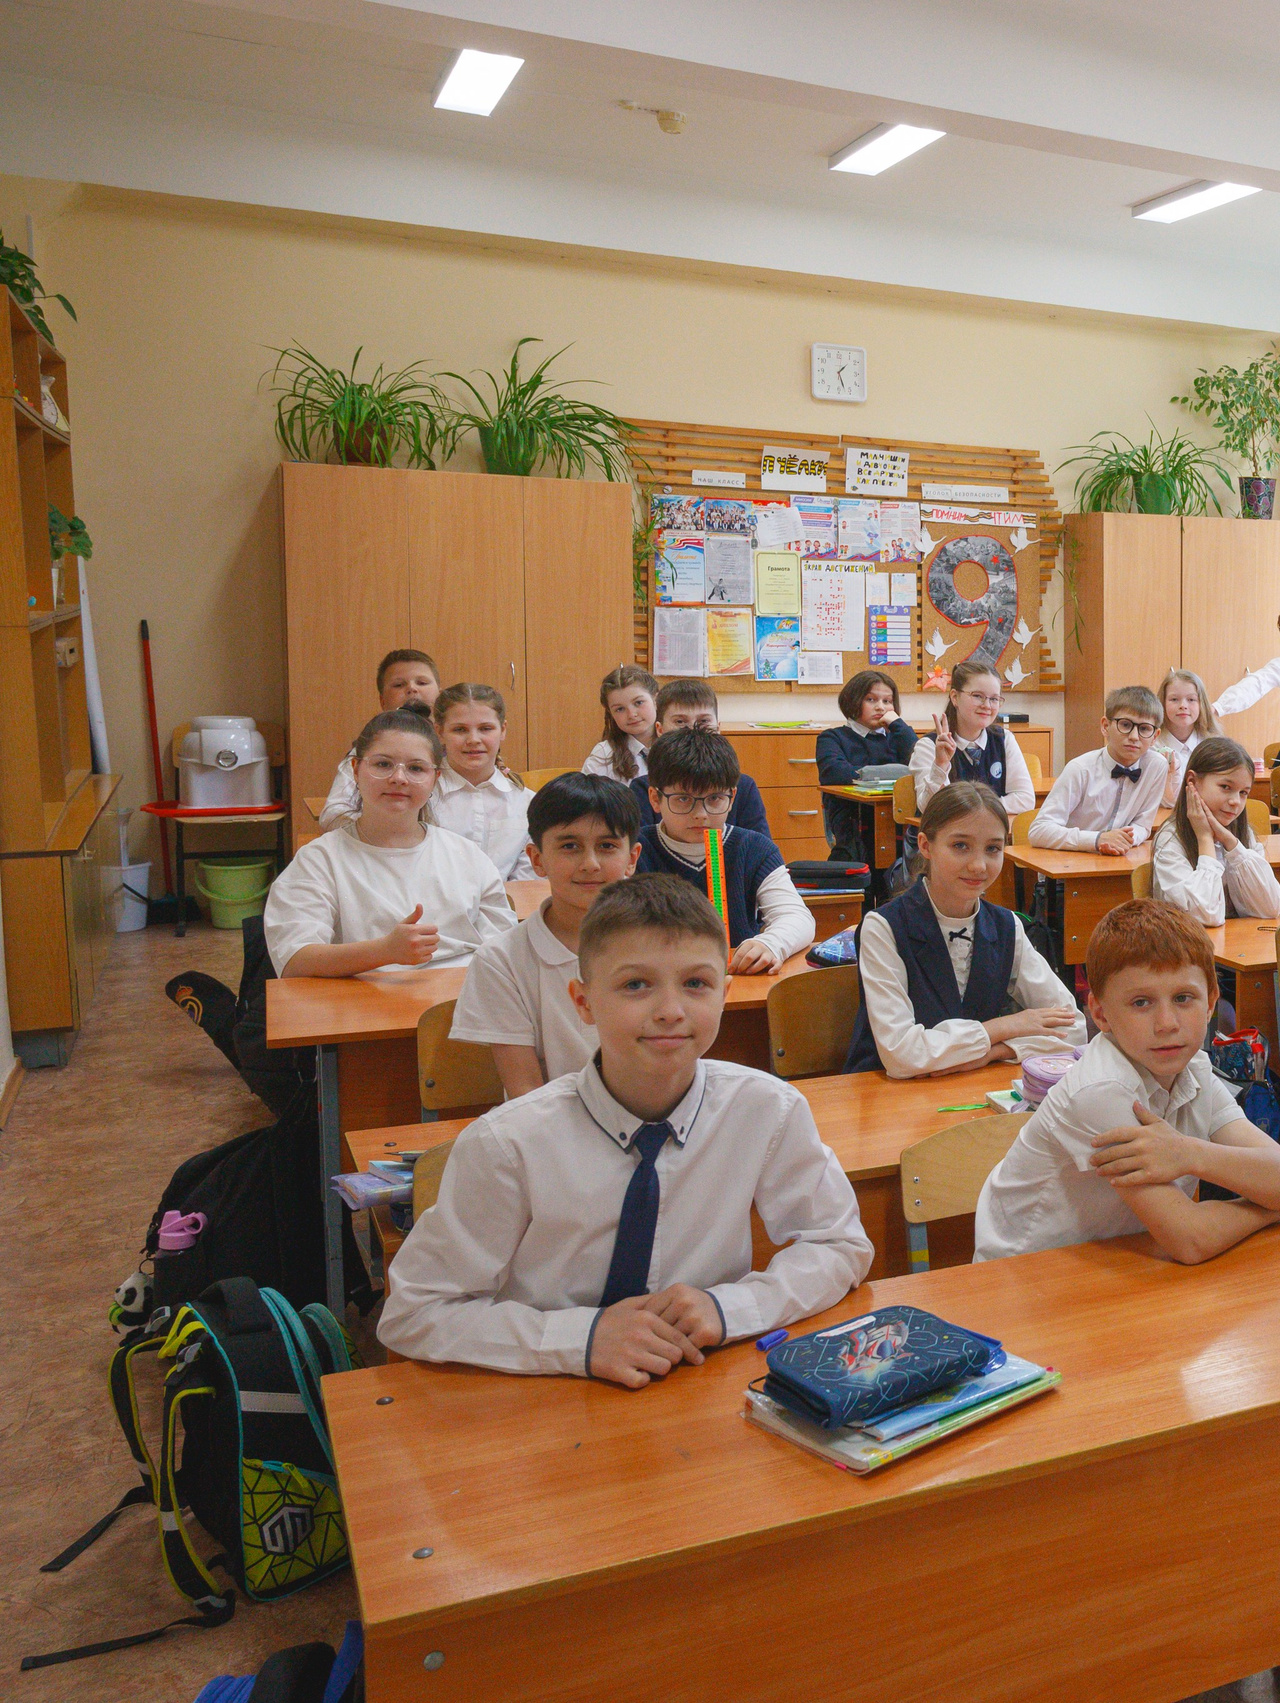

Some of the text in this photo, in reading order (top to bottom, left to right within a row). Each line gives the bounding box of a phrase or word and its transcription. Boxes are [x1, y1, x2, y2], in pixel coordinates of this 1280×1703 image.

[857, 467, 872, 476] ВСЕ
[856, 476, 870, 485] КАК
[931, 508, 1025, 524] ПОМНИМ ЧТИМ
[825, 564, 874, 573] ДОСТИЖЕНИЙ
